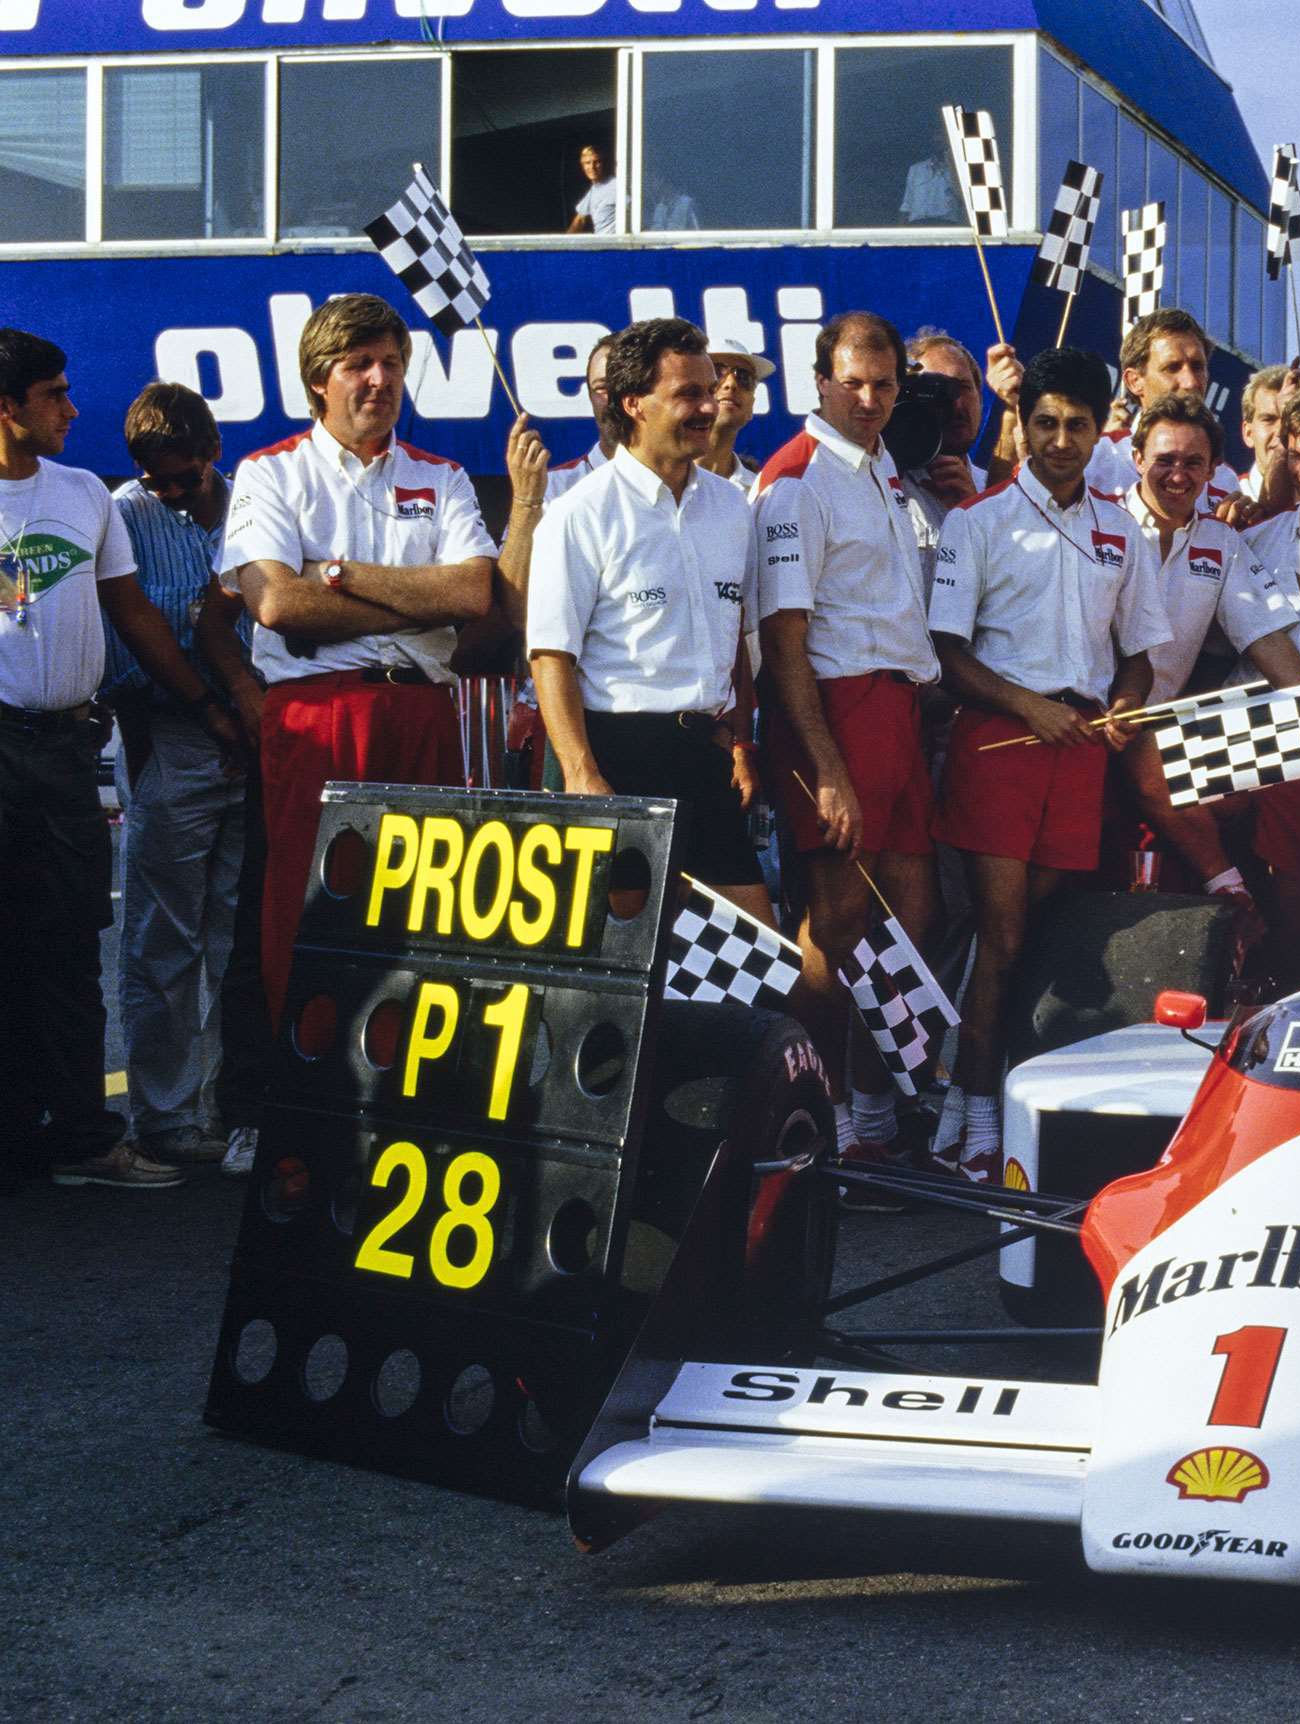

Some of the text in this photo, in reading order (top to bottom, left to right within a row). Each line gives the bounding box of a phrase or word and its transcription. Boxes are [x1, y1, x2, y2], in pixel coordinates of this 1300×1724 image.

[154, 286, 826, 422] olveti
[766, 522, 799, 538] BOSS
[628, 587, 667, 604] BOSS
[1189, 559, 1222, 577] Marlboro
[366, 813, 613, 949] PROST
[355, 1141, 501, 1290] 28
[722, 1371, 1020, 1417] Shell
[1207, 1325, 1288, 1429] 1
